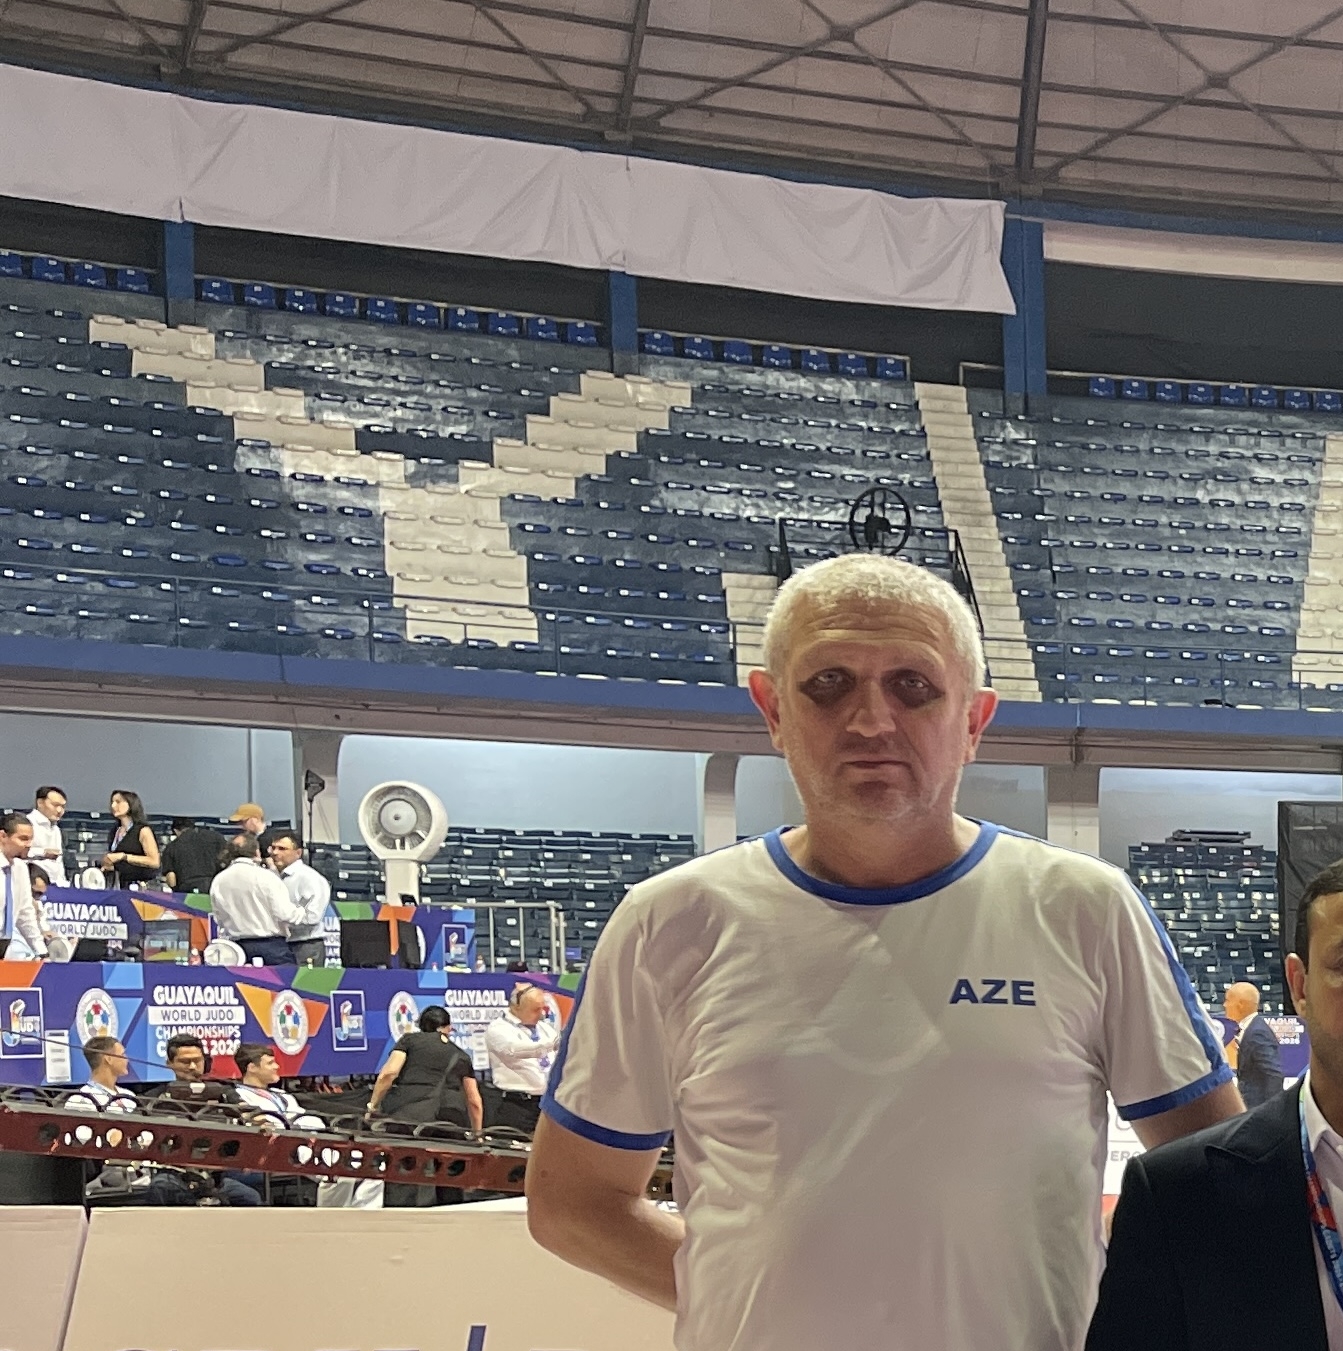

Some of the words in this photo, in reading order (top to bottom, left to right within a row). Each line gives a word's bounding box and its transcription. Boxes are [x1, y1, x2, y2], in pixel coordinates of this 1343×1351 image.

[45, 902, 122, 922] GUAYAQUIL
[90, 924, 118, 938] JUDO
[153, 985, 240, 1006] GUAYAQUIL
[445, 989, 509, 1007] GUAYAQUIL
[949, 978, 1037, 1007] AZE
[161, 1009, 202, 1022] WORLD
[205, 1009, 235, 1022] JUDO
